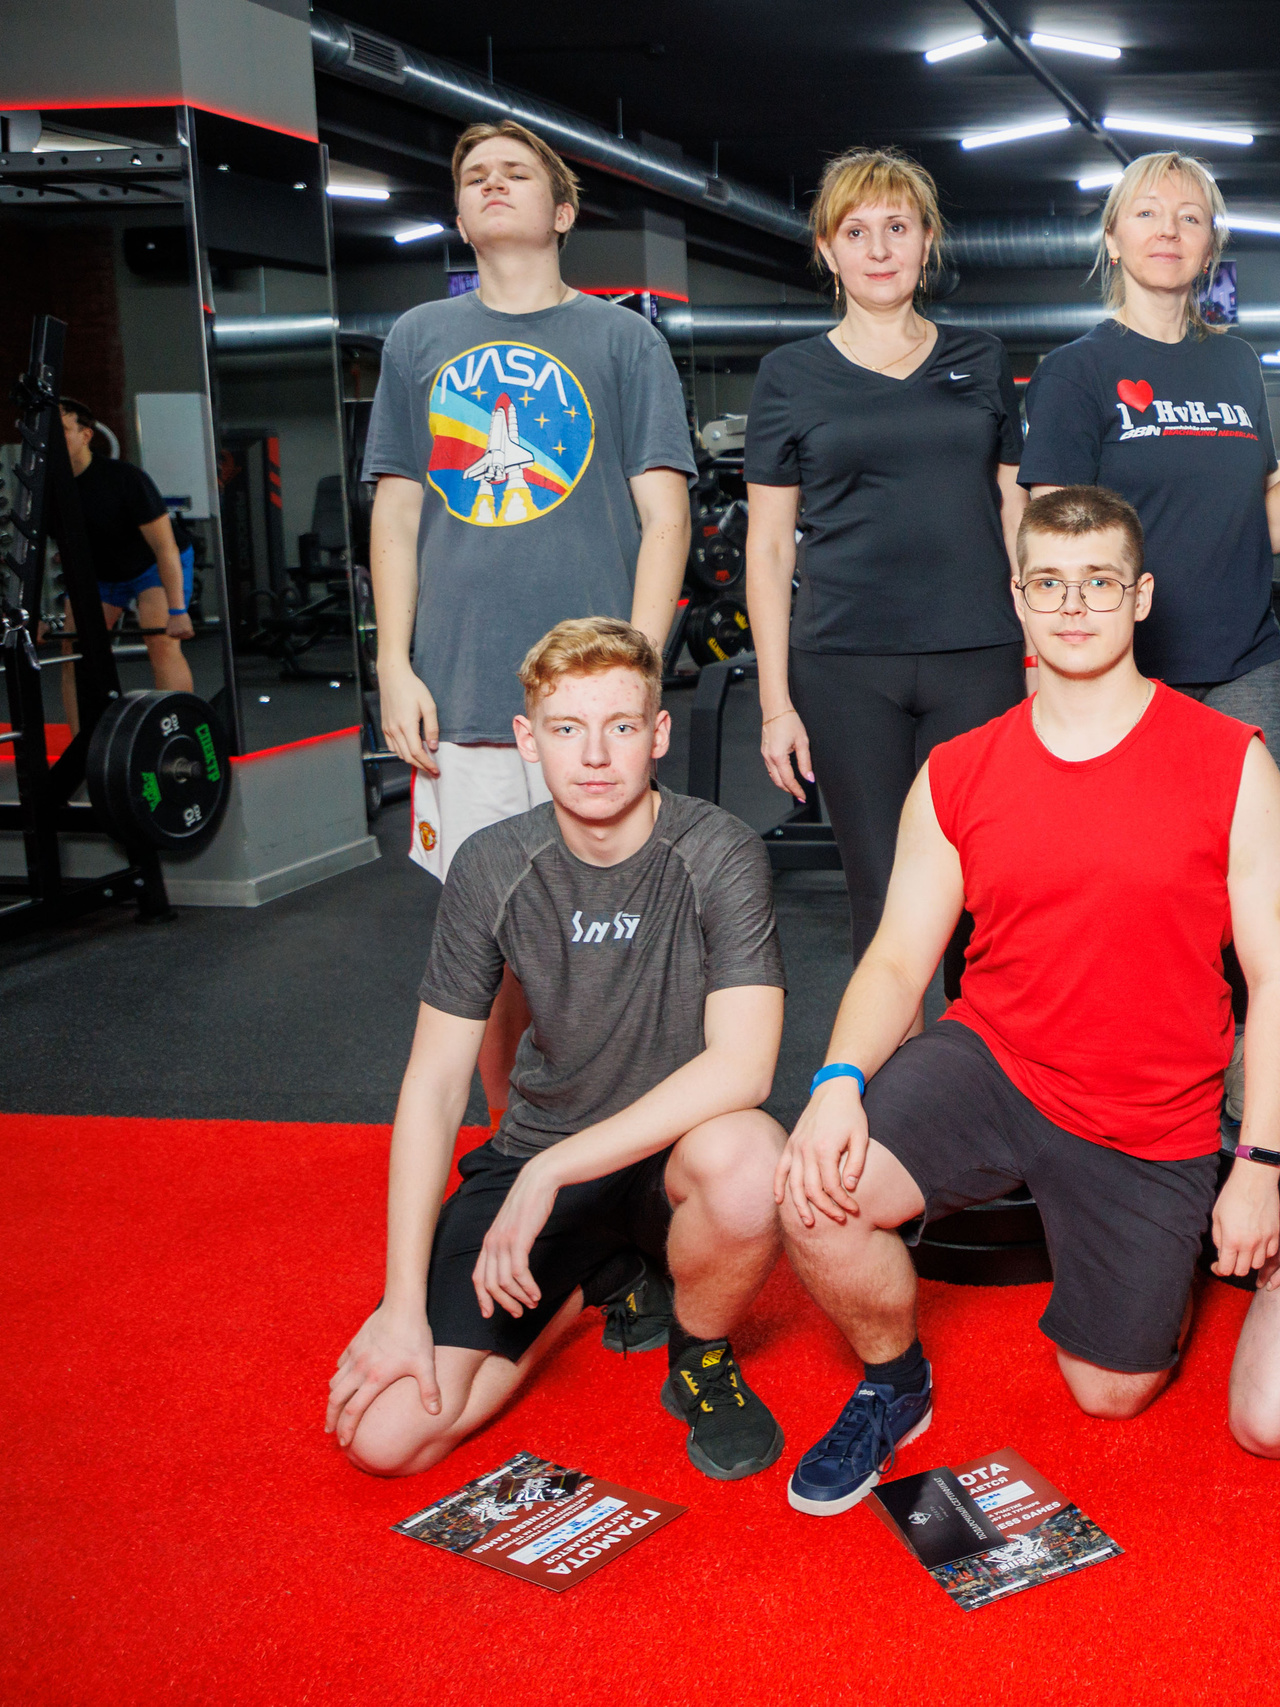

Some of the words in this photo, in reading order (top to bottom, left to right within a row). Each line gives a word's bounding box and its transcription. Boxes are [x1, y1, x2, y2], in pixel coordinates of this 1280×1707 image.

[440, 348, 568, 407] NASA
[1119, 425, 1161, 441] BBN
[195, 723, 221, 783] СПЕКТР
[510, 1506, 556, 1533] FITNESS
[1022, 1501, 1061, 1520] GAMES
[472, 1531, 512, 1554] GAMES
[543, 1510, 633, 1565] НАГРАЖДАЕТСЯ
[546, 1509, 662, 1575] ГРАМОТА
